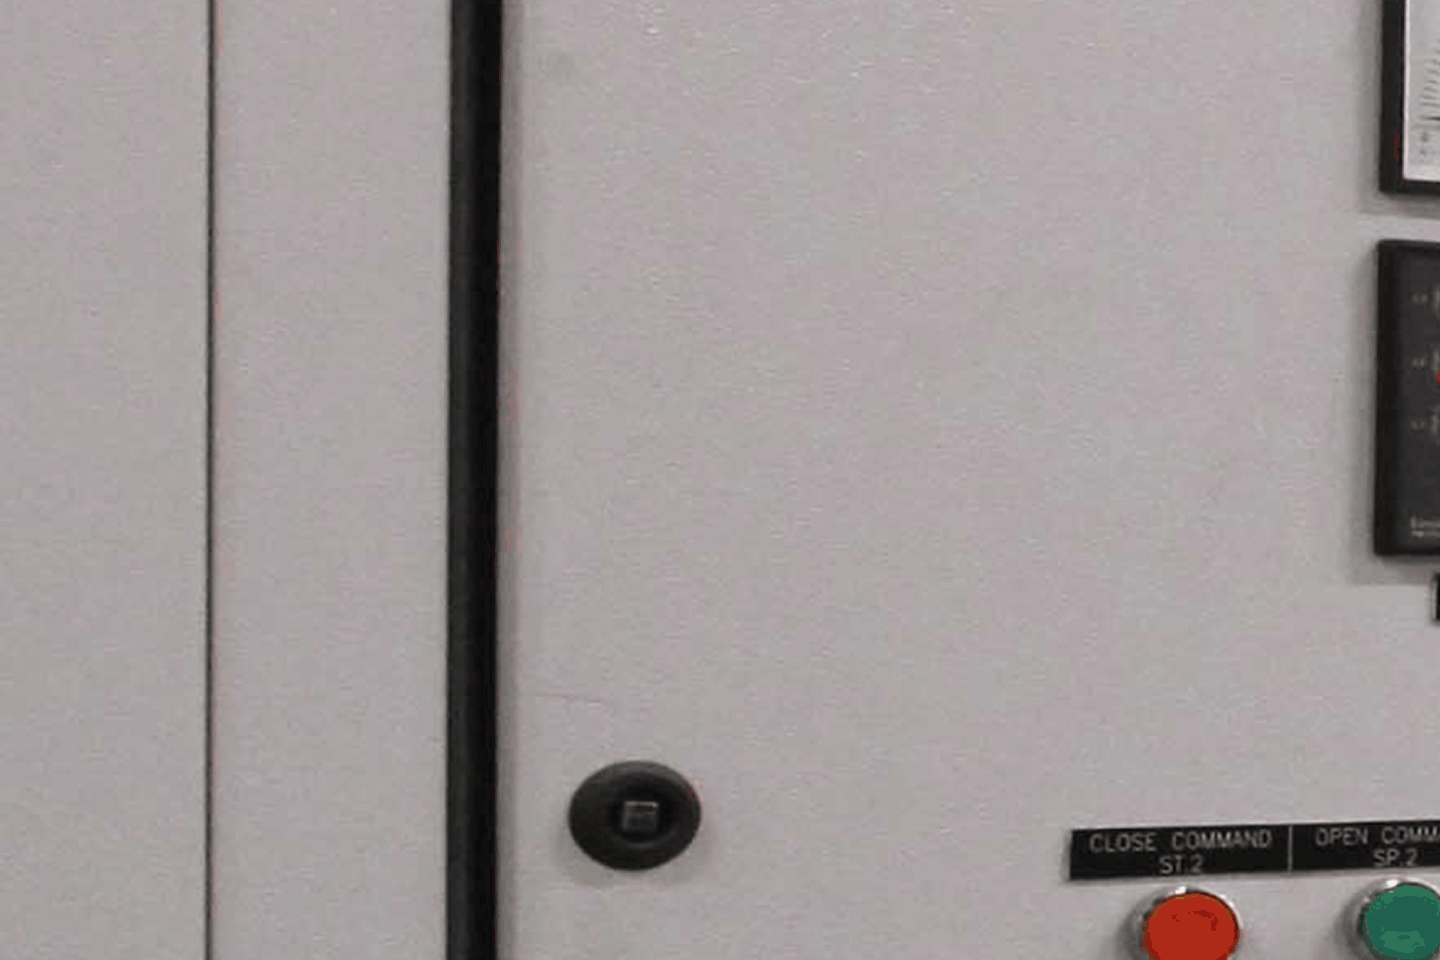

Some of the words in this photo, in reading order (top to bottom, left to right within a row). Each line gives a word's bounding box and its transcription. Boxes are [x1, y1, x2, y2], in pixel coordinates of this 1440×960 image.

[1088, 831, 1158, 854] CLOSE
[1171, 828, 1274, 852] COMMAND
[1314, 826, 1371, 848] OPEN
